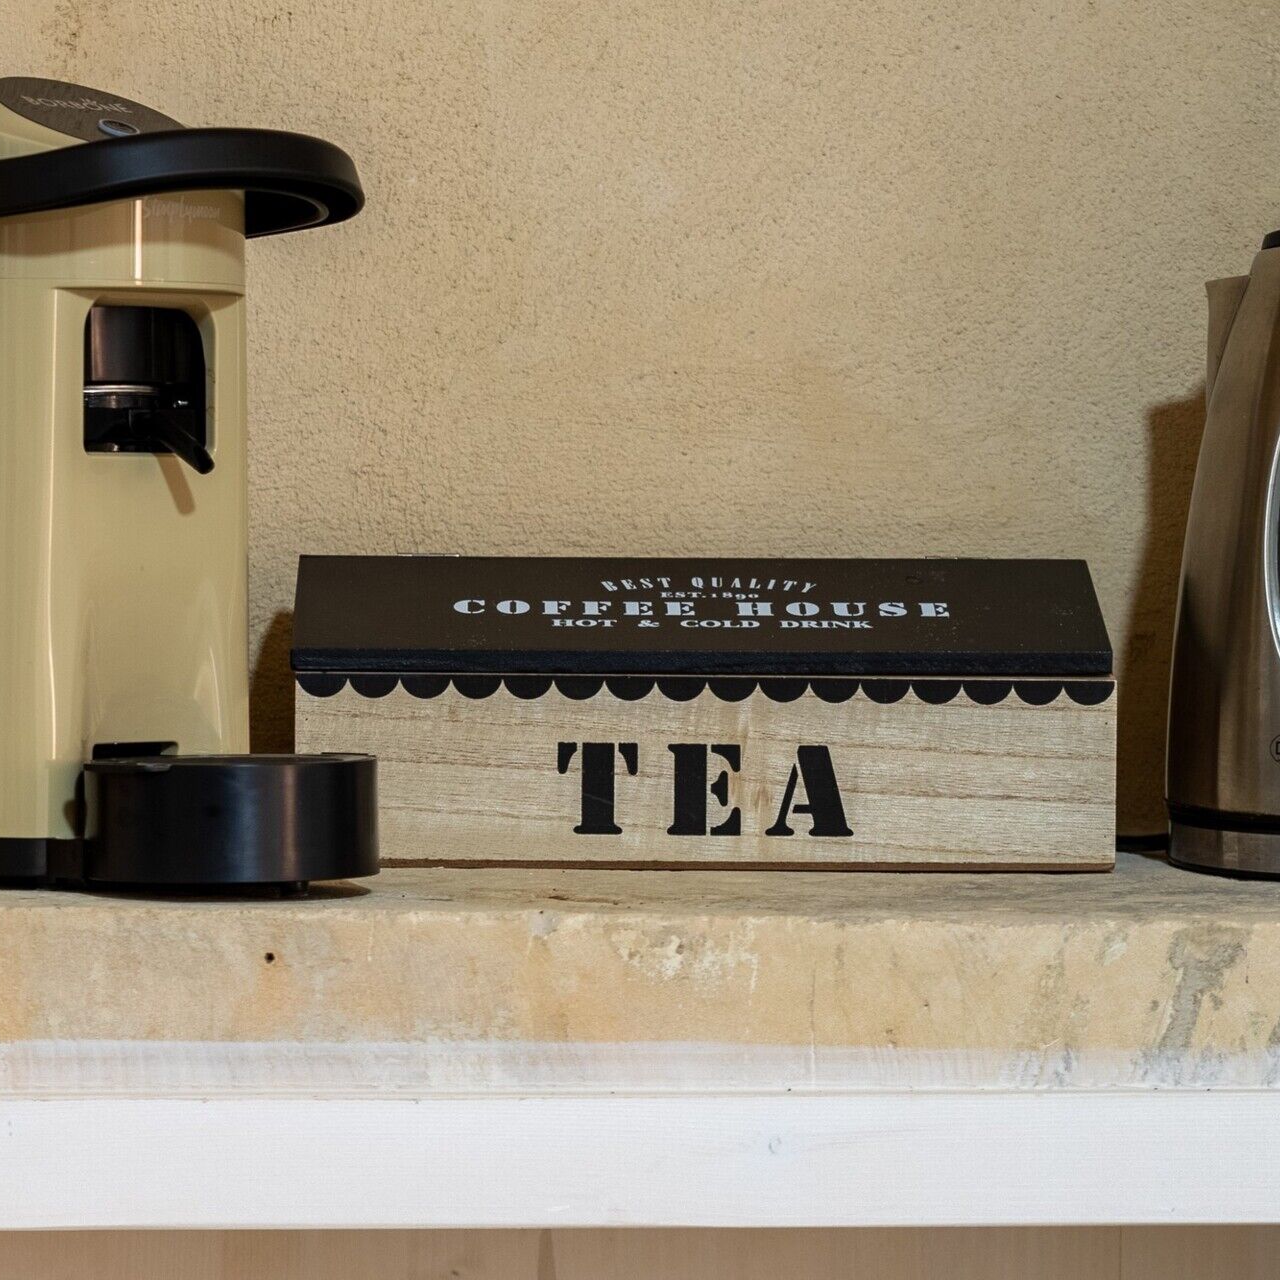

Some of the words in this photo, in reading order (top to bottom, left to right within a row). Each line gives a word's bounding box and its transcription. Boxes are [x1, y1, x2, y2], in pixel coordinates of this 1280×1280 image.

[601, 577, 671, 592] BEST
[691, 577, 817, 593] QUALITY
[453, 599, 696, 616] COFFEE
[736, 602, 950, 618] HOUSE
[552, 619, 618, 628] HOT
[637, 619, 660, 628] &
[680, 620, 761, 629] COLD
[780, 620, 873, 629] DRINK
[557, 741, 854, 837] TEA
